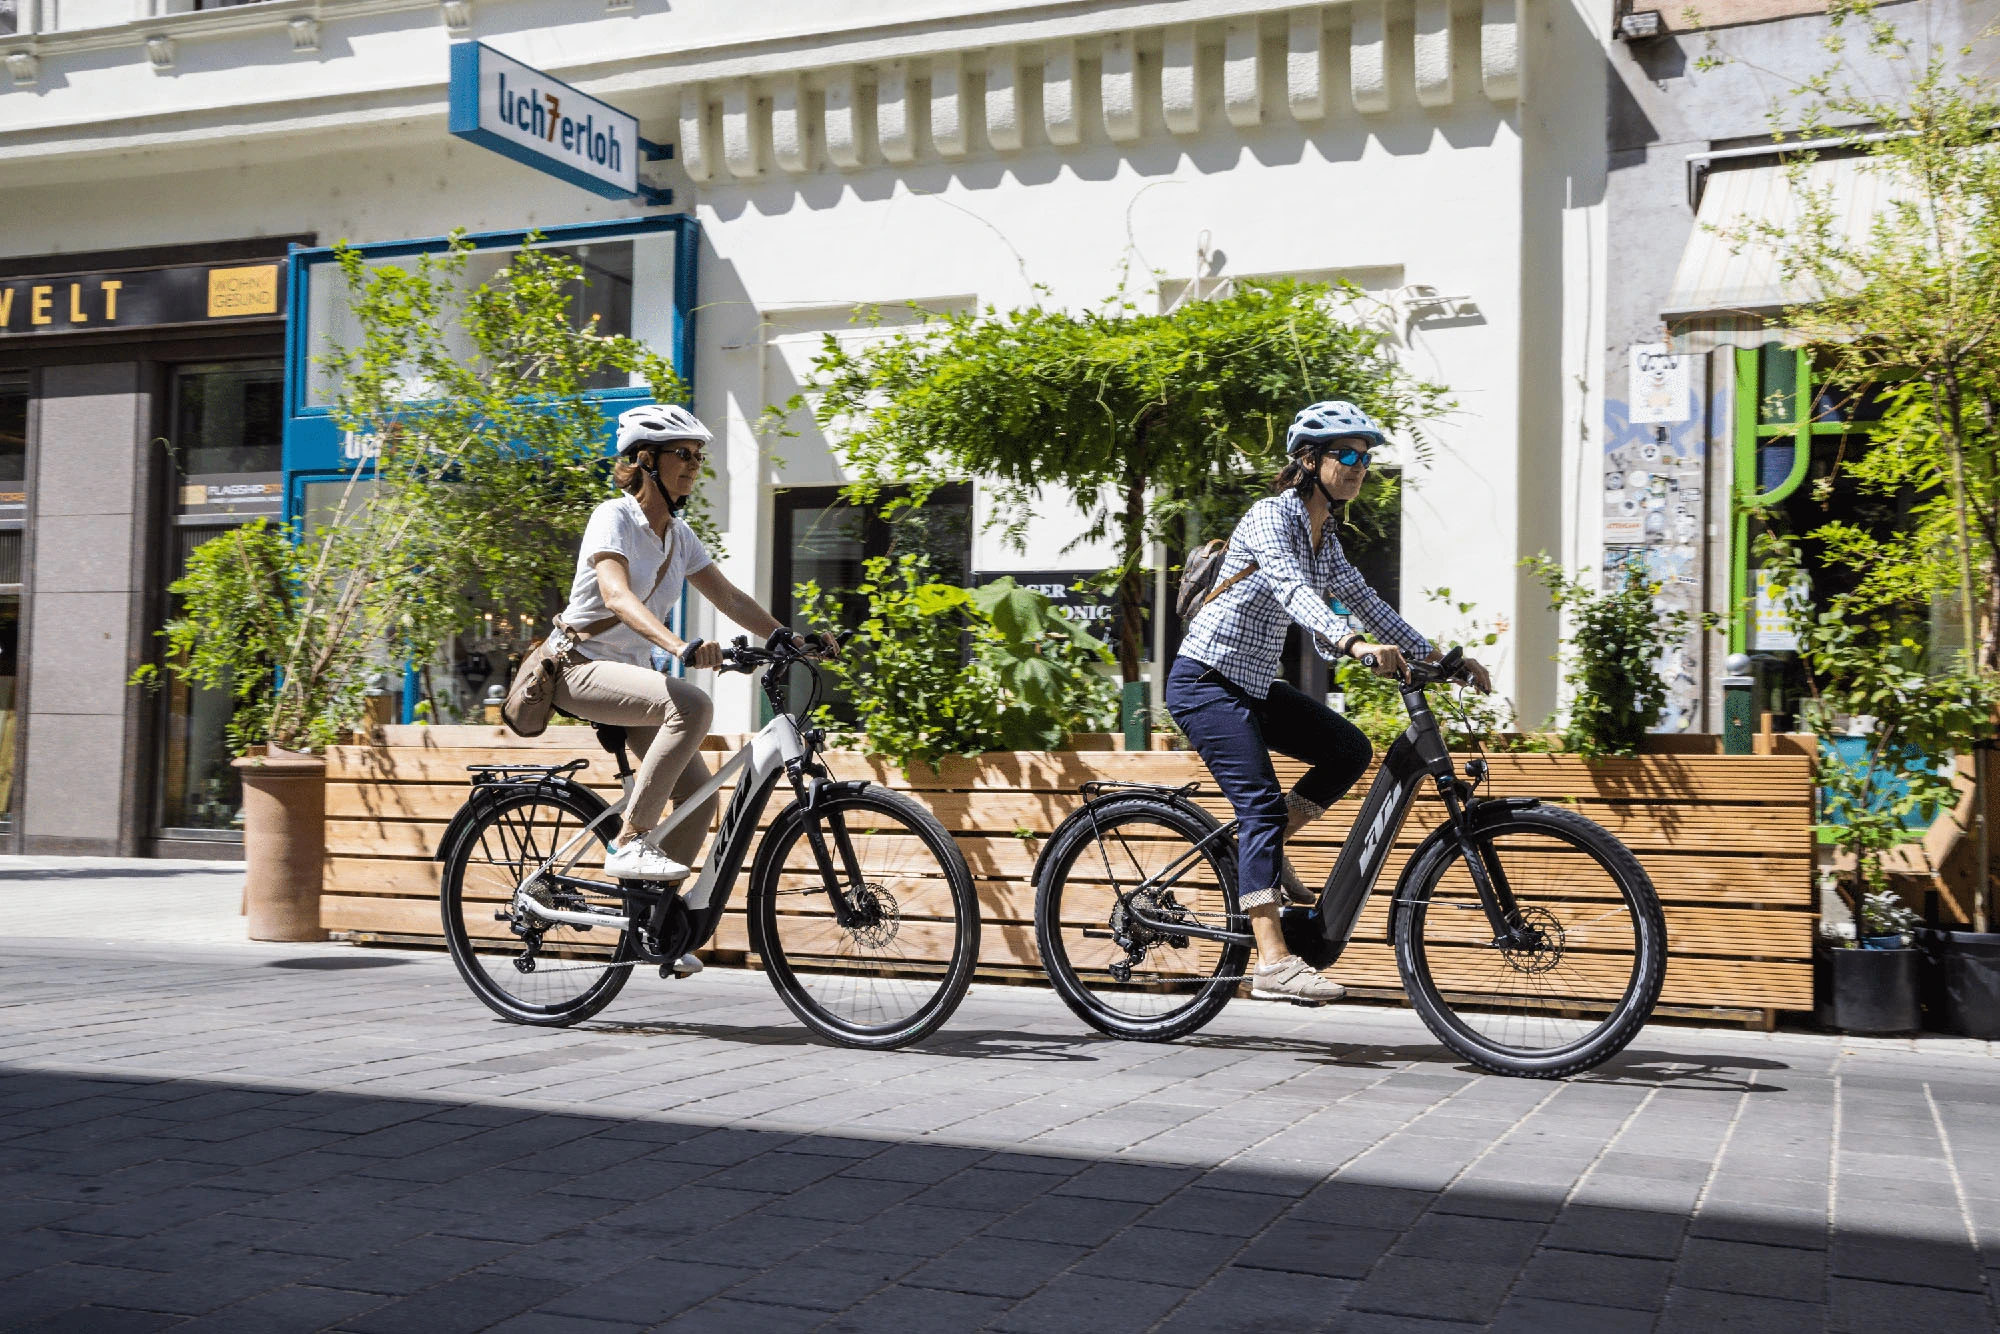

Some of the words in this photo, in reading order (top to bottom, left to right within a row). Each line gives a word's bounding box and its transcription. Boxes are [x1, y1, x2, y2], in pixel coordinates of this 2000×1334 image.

[1059, 605, 1112, 620] ONIG
[714, 767, 752, 874] KTM
[1359, 780, 1402, 878] KTM
